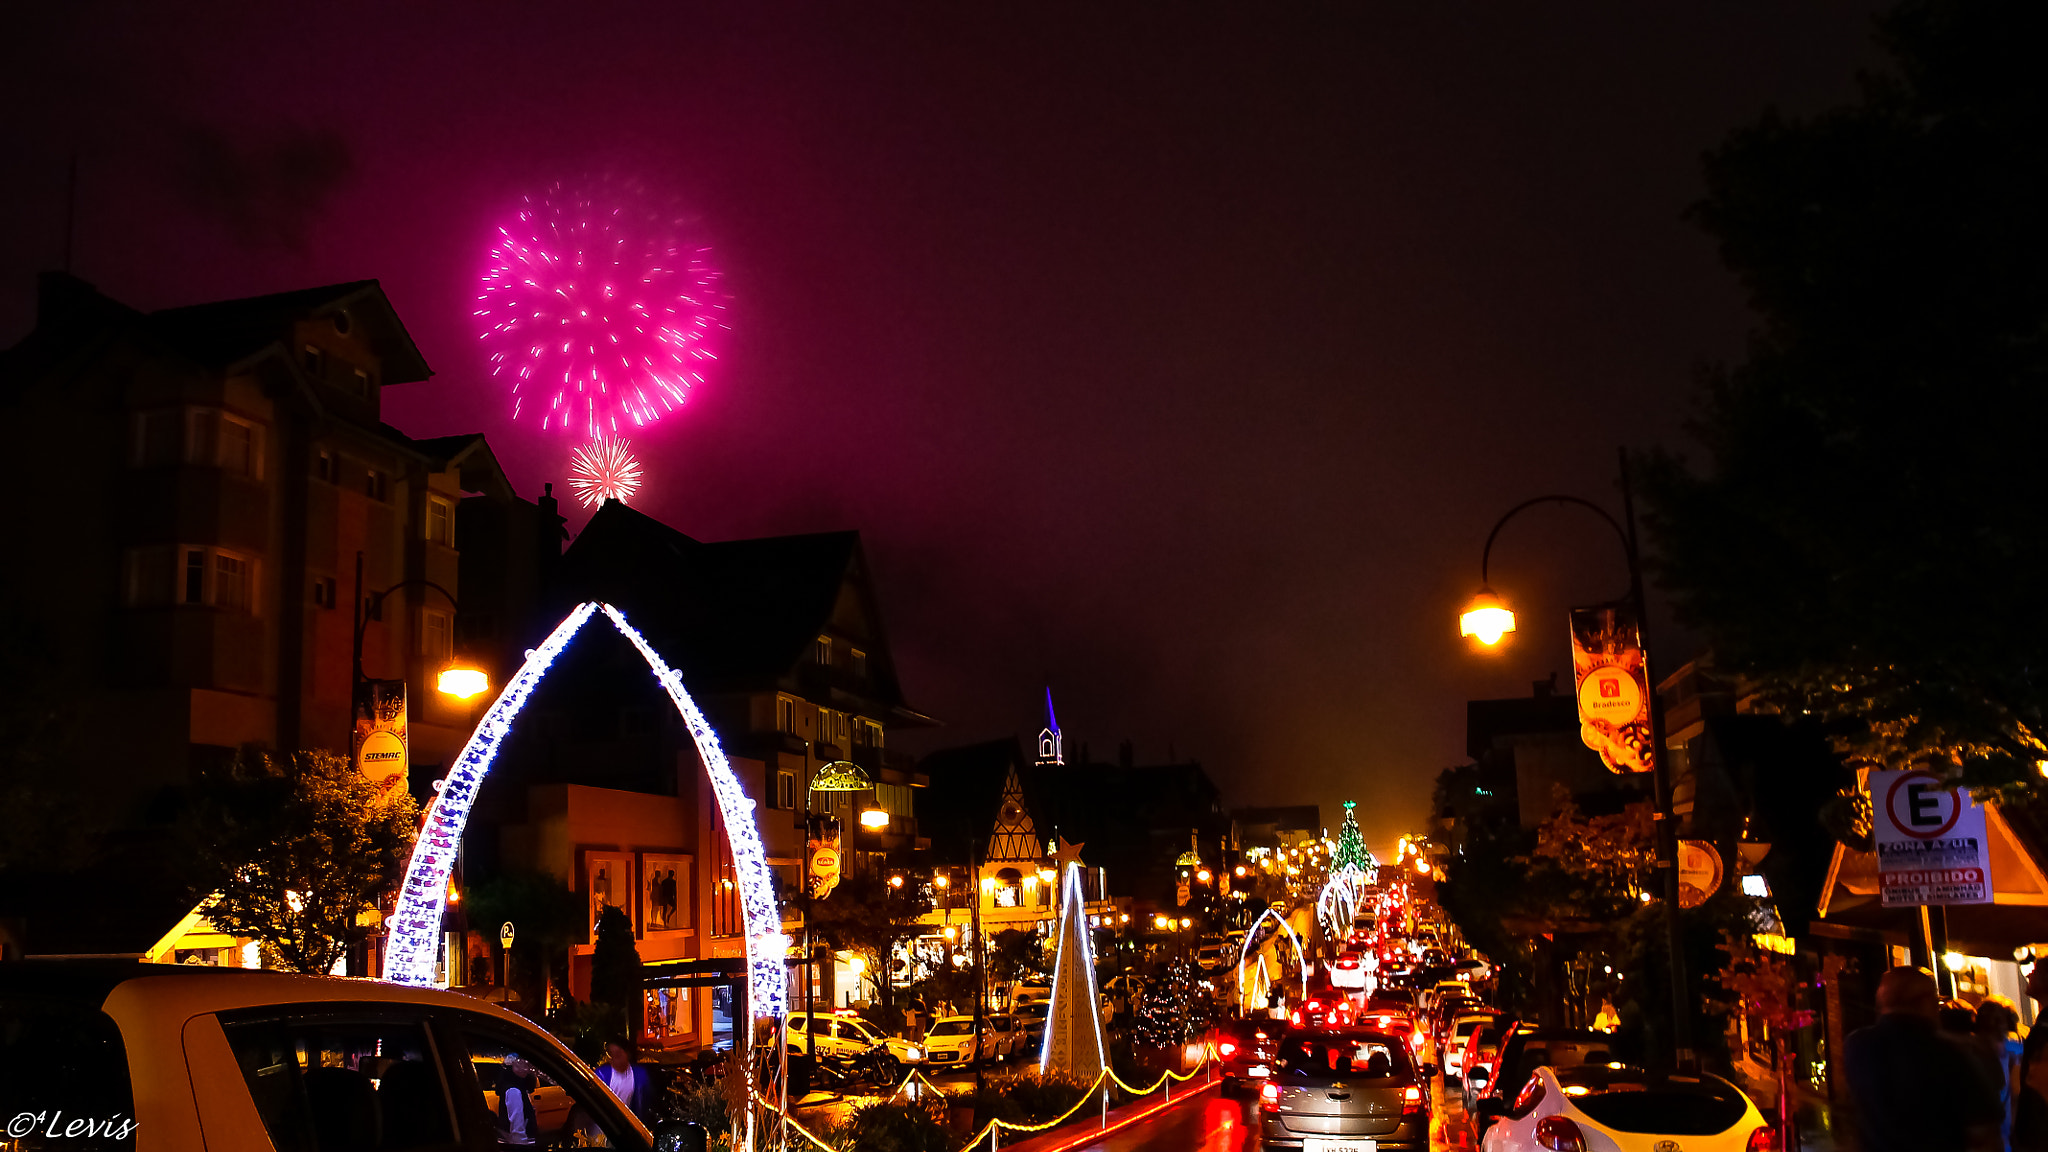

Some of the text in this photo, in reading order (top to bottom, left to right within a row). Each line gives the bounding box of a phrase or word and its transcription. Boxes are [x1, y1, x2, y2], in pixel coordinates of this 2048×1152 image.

[1592, 700, 1631, 709] Bradesco
[364, 751, 402, 760] STEMAC
[1908, 784, 1943, 826] E
[1883, 838, 1970, 853] ZONA AZUL
[1885, 870, 1978, 885] PROIBIDO
